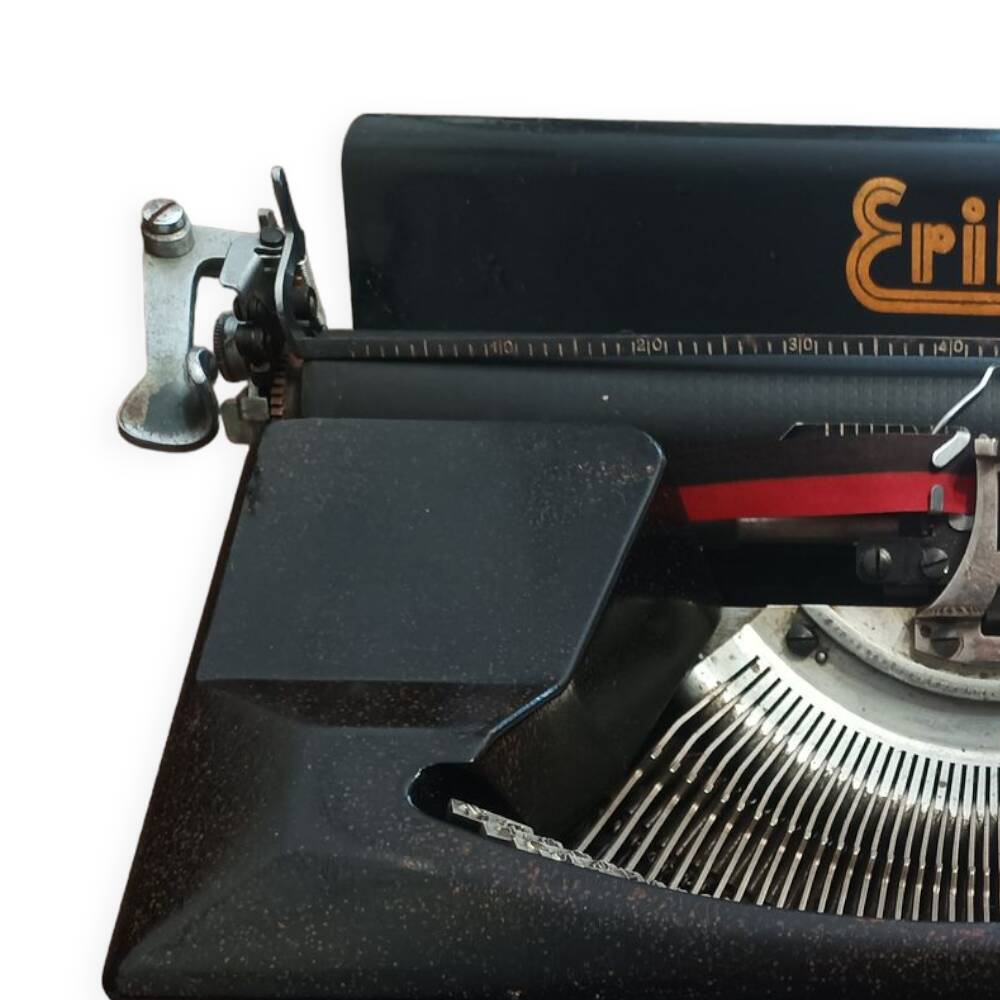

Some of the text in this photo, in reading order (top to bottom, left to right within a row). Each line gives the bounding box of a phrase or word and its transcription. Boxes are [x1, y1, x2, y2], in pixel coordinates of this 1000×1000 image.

[636, 337, 663, 353] 20
[787, 336, 813, 352] 30
[937, 340, 964, 354] 40
